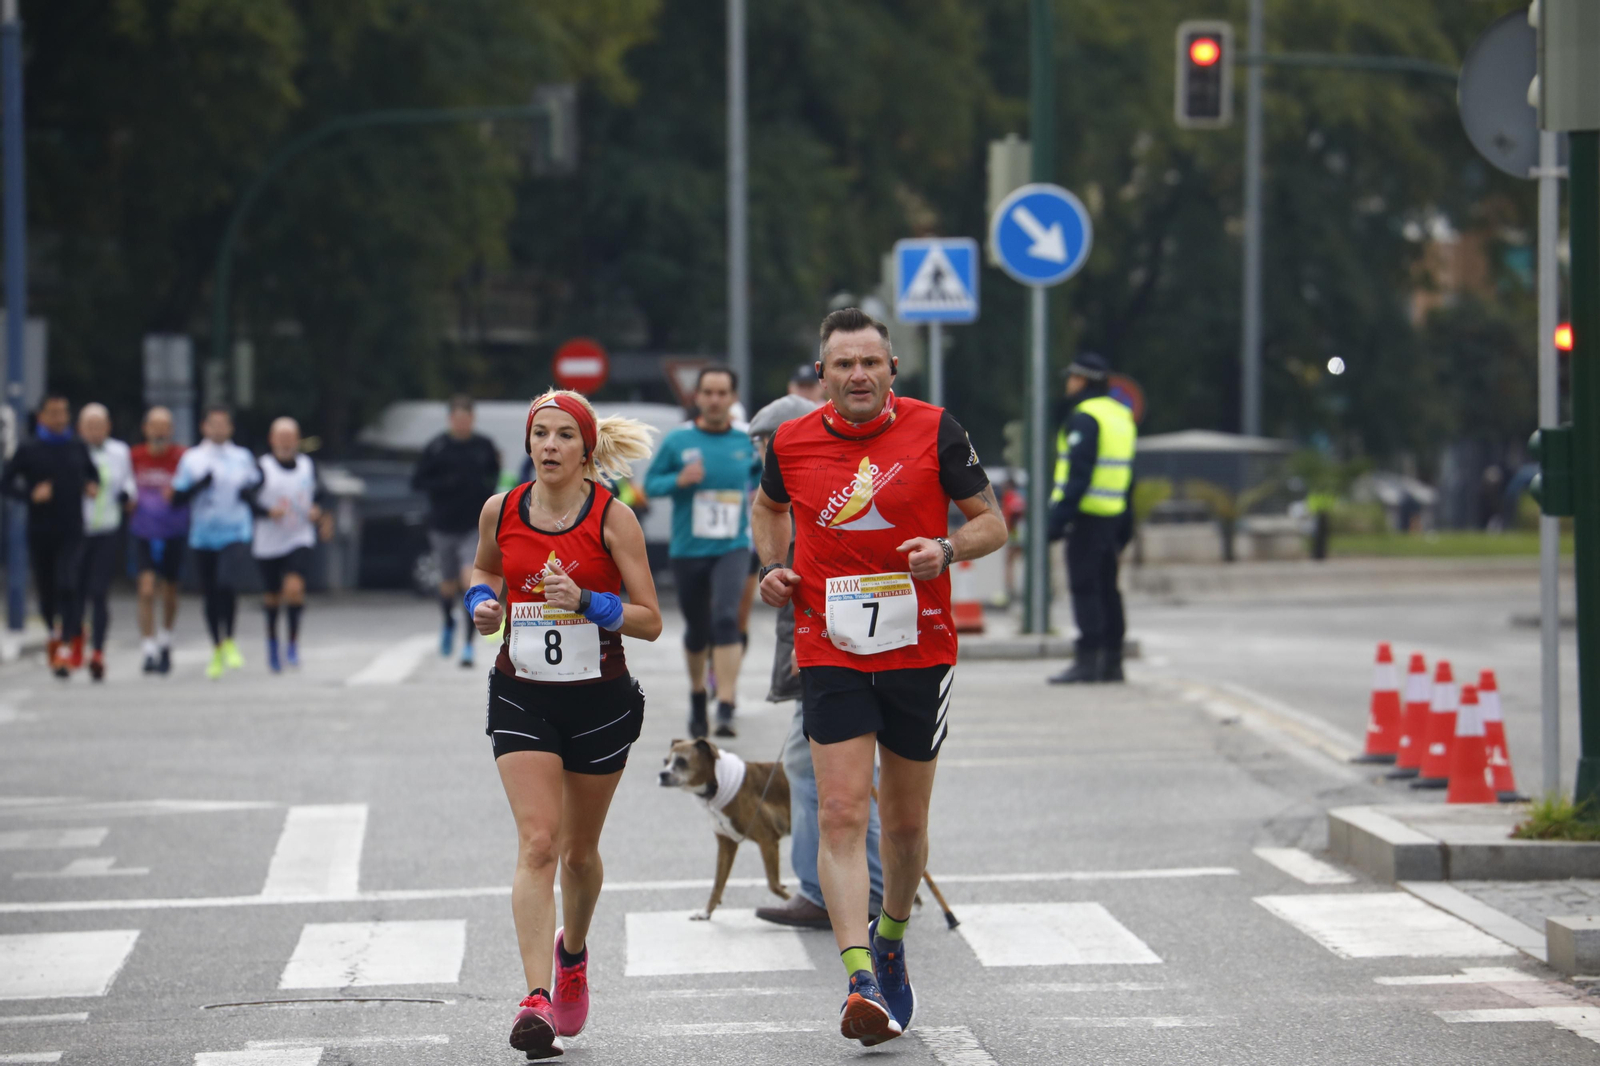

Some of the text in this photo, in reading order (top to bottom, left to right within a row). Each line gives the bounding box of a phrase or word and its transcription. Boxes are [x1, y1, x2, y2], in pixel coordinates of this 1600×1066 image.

[816, 463, 879, 528] verticalia
[709, 504, 727, 526] 31
[829, 579, 860, 594] XXXIX
[874, 589, 912, 598] TRINITARIOS
[514, 605, 543, 619] XXXIX
[862, 602, 879, 638] 7
[544, 629, 562, 666] 8
